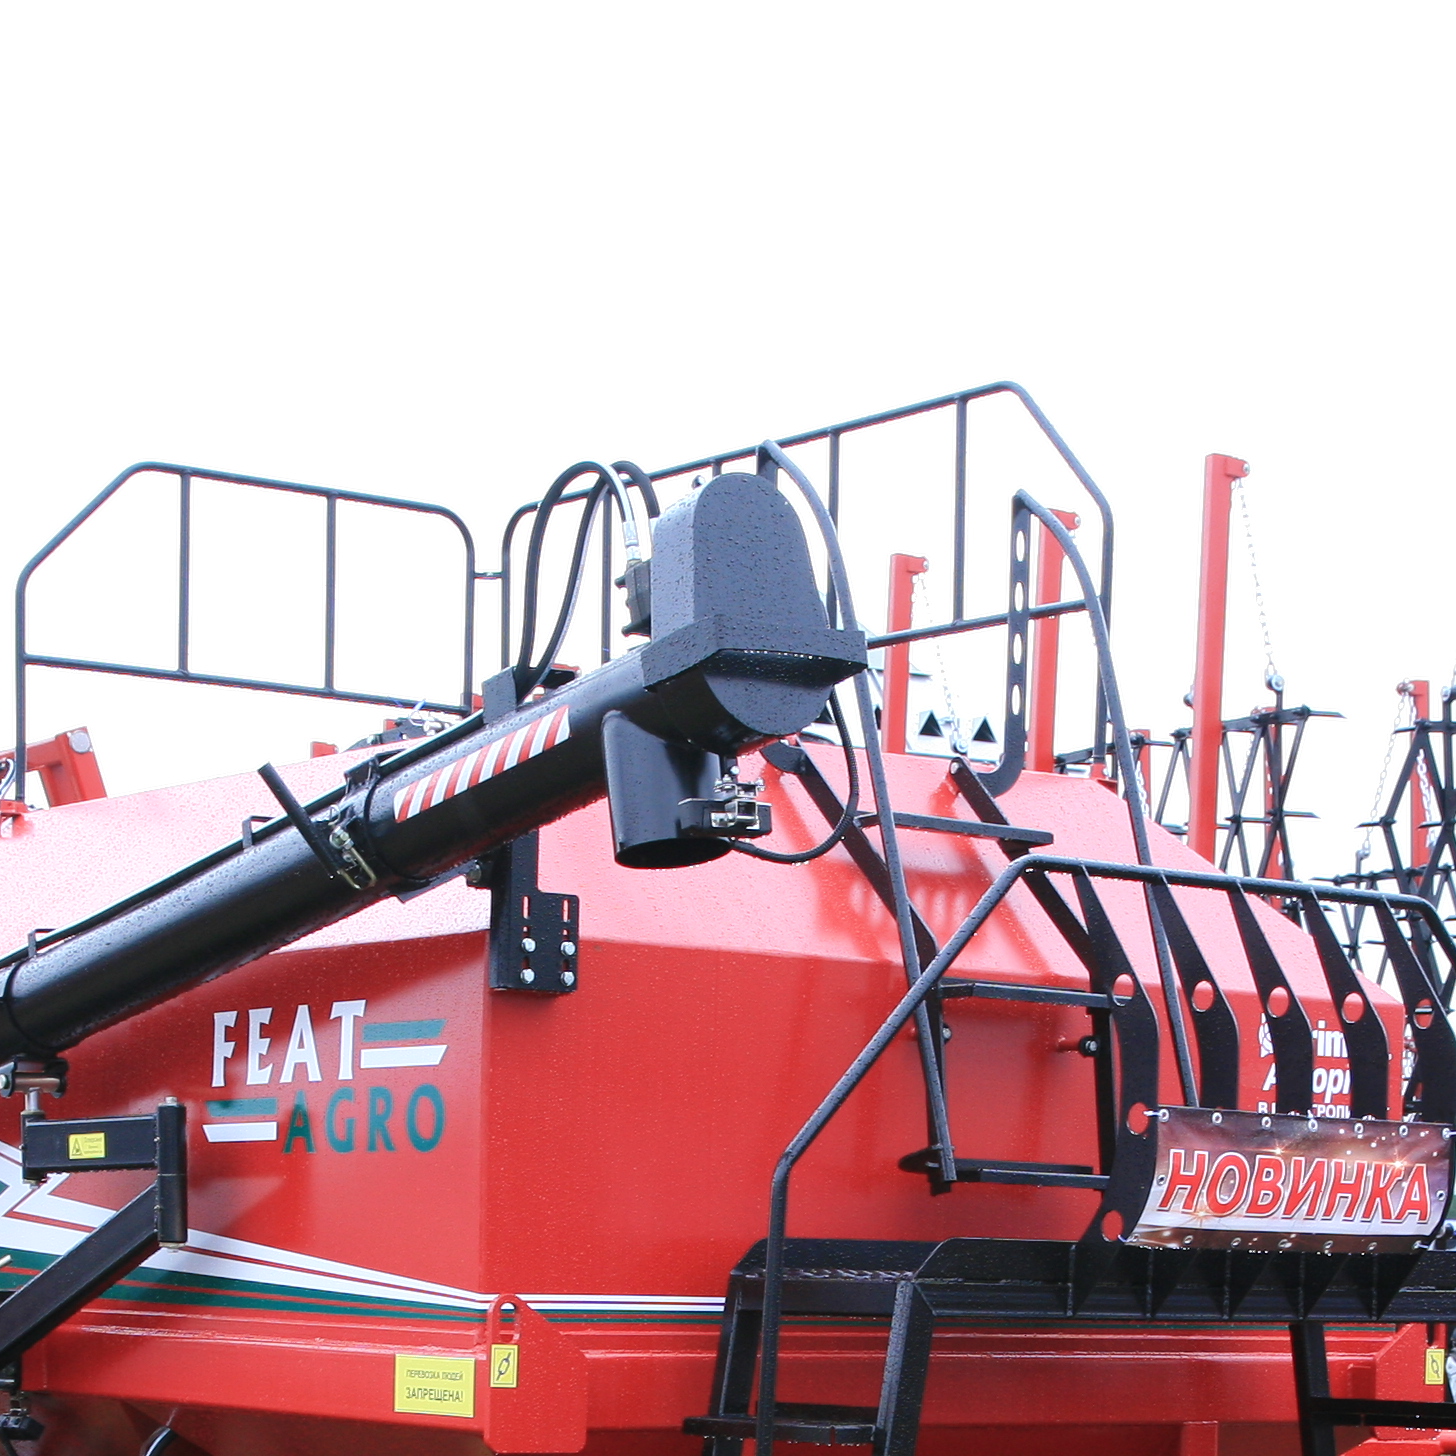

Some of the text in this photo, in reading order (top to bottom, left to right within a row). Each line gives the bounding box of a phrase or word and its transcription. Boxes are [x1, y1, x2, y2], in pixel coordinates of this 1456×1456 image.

[211, 999, 367, 1088] FEAT
[283, 1083, 446, 1154] AGRO
[1156, 1148, 1432, 1224] НОВИНКА
[405, 1368, 441, 1380] ПЕРЕВОЗКА
[405, 1386, 464, 1403] ЗАПРЕЩЕНА!
